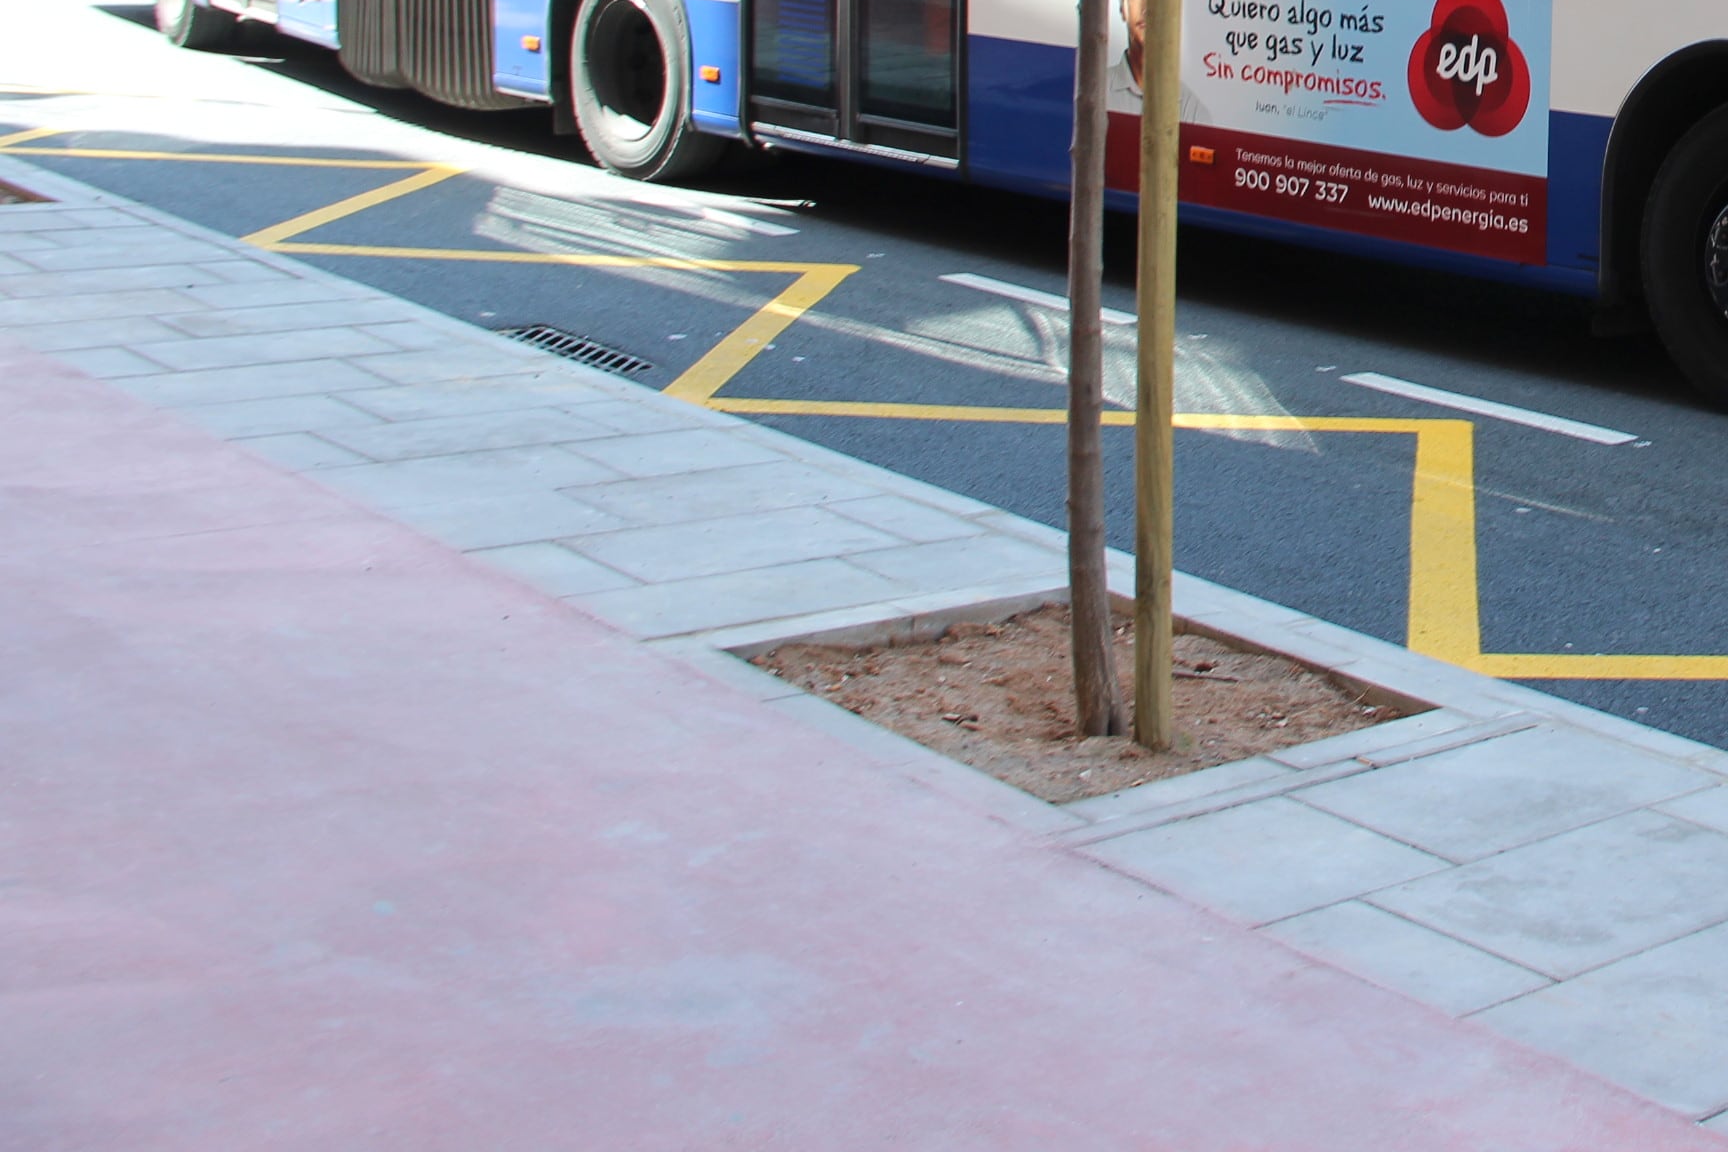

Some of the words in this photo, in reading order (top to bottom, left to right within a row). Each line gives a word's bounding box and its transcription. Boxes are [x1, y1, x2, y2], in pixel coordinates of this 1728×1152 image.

[1287, 0, 1332, 35] algo
[1340, 5, 1385, 33] más
[1226, 30, 1258, 56] que
[1266, 33, 1303, 62] gas
[1311, 39, 1324, 66] y
[1332, 34, 1364, 63] luz
[1436, 33, 1498, 96] edp
[1203, 52, 1234, 79] Sin
[1241, 63, 1387, 100] compromisos.
[1235, 148, 1282, 168] Tenemos
[1284, 155, 1295, 169] la
[1297, 159, 1327, 176] mejor
[1328, 163, 1362, 181] oferta
[1364, 168, 1378, 184] de
[1381, 174, 1404, 189] gas,
[1407, 174, 1423, 191] luz
[1426, 182, 1434, 193] y
[1436, 182, 1486, 200] servicios
[1489, 189, 1517, 206] para
[1235, 167, 1270, 191] 900
[1275, 173, 1310, 197] 907
[1315, 181, 1349, 204] 337
[1368, 194, 1529, 233] www.edpenergia.es
